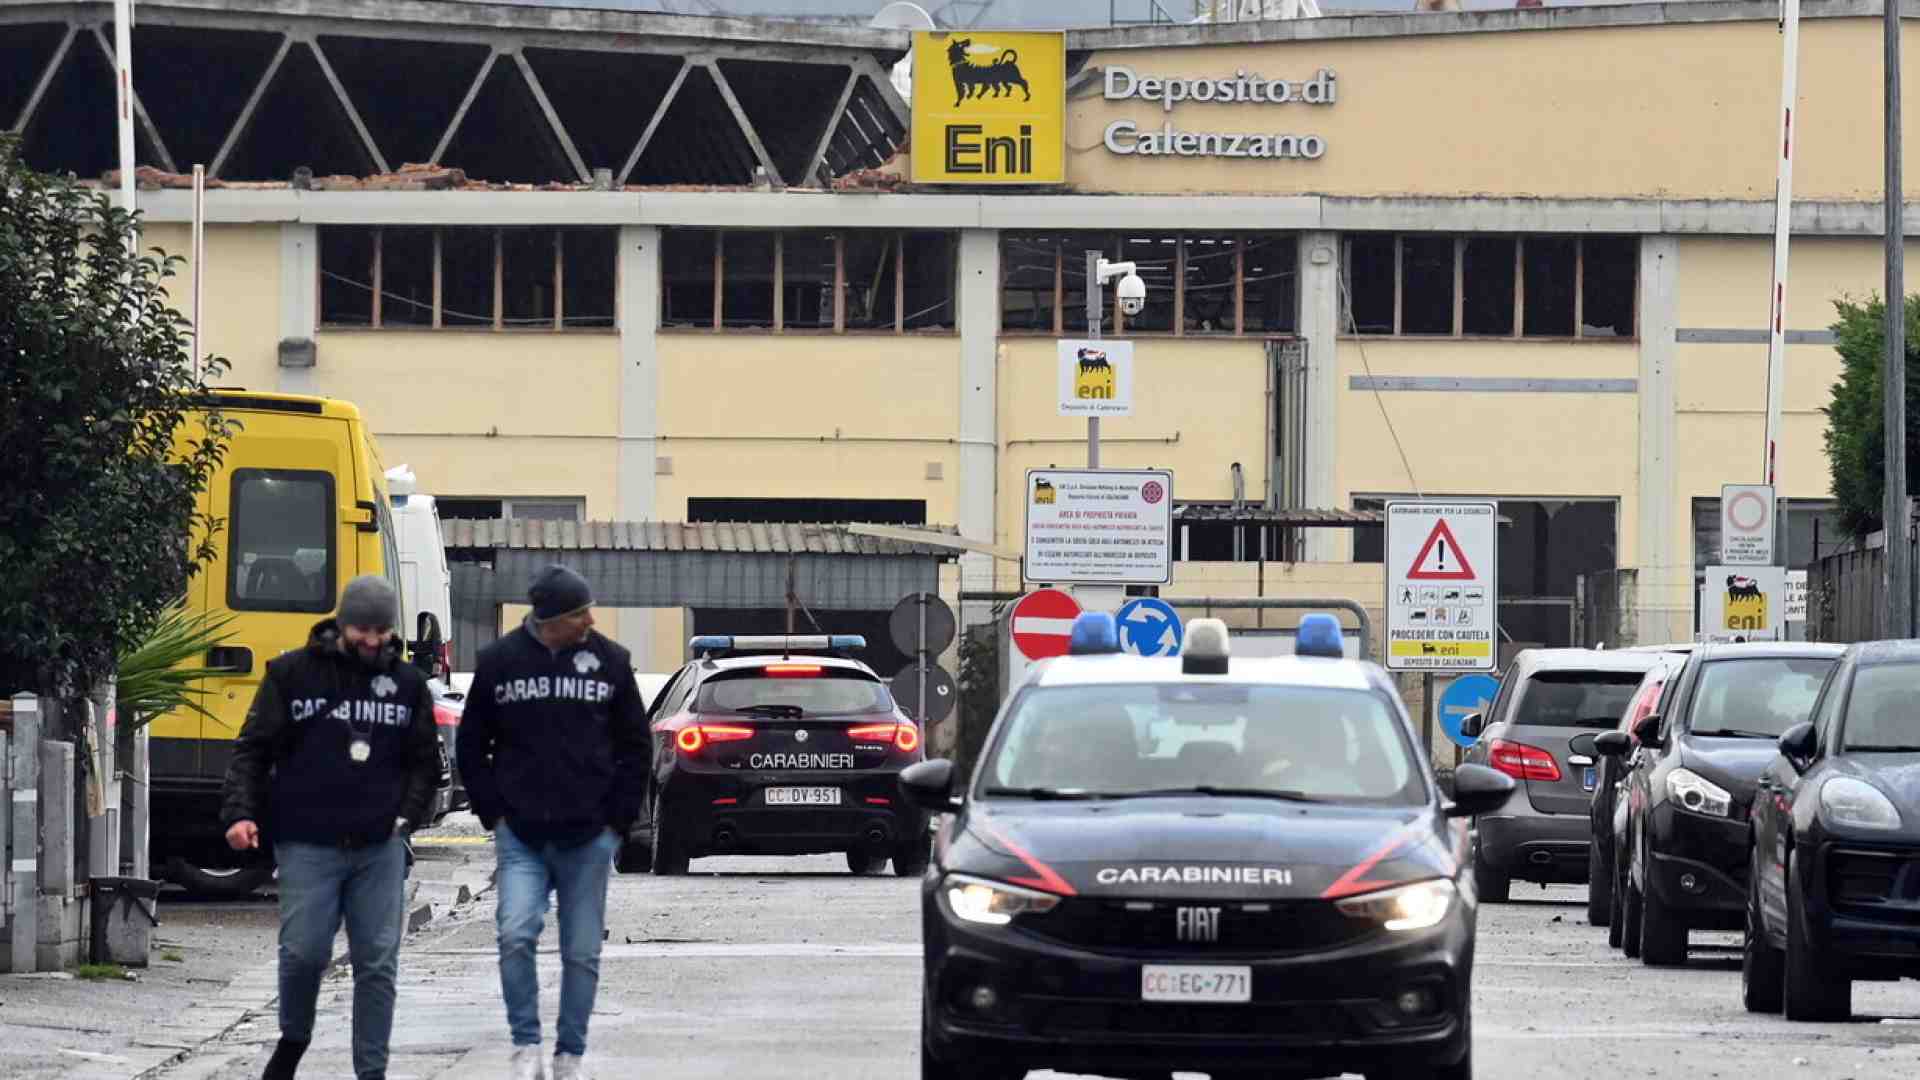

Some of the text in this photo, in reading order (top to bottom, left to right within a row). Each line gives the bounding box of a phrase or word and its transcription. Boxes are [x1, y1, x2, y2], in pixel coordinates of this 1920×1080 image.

[1104, 64, 1336, 112] Deposito di
[945, 124, 1032, 174] Eni
[1104, 119, 1325, 160] Calenzano
[1078, 379, 1112, 400] eni
[1728, 608, 1762, 630] eni
[1391, 630, 1490, 640] PROCEDERE CON CAUTELA
[1440, 642, 1460, 656] eni
[1403, 658, 1432, 666] DEPOSITO
[1441, 658, 1477, 666] CALENZANO
[750, 752, 854, 769] CARABINIERI
[1096, 866, 1292, 886] CARABINIERI
[1176, 906, 1222, 941] FIAT
